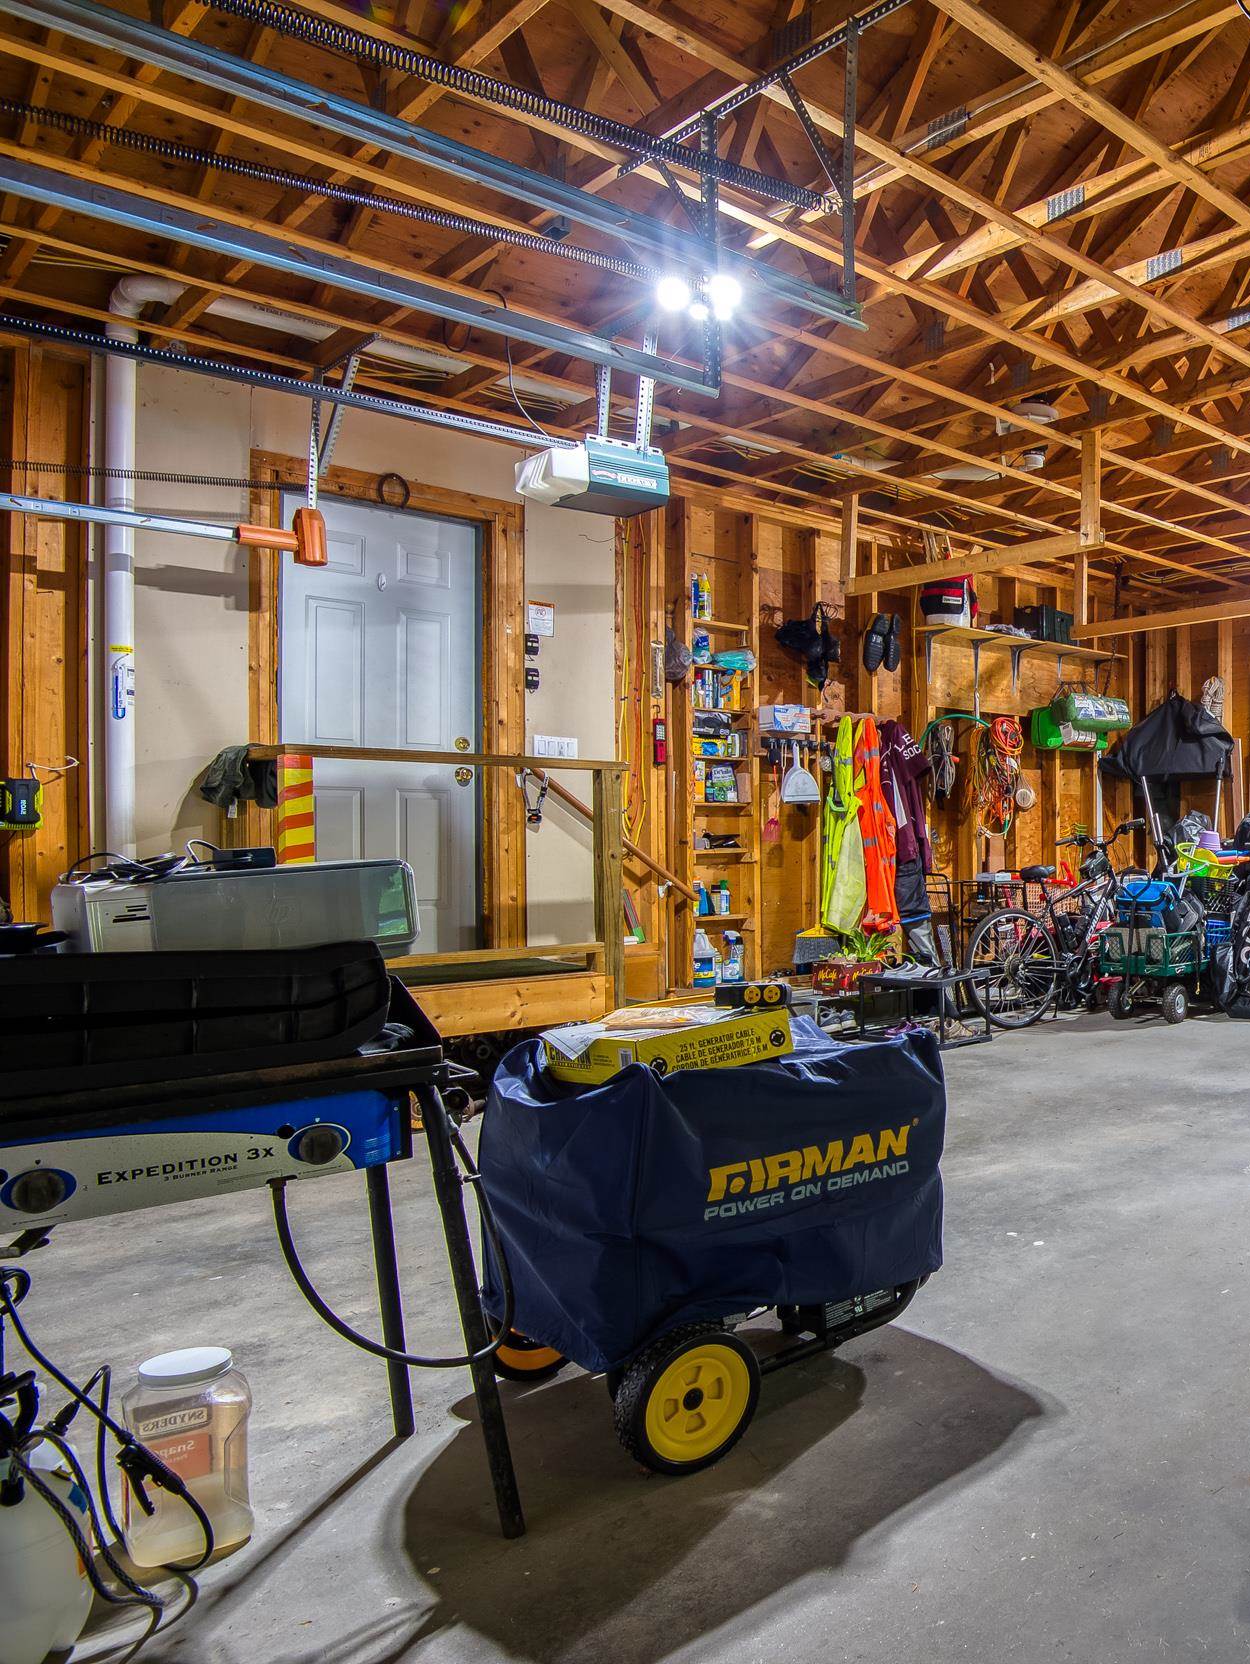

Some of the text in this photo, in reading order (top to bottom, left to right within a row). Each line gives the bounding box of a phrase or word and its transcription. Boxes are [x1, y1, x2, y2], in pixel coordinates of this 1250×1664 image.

[675, 1052, 696, 1063] CABLE
[698, 1048, 707, 1057] DE
[708, 1040, 744, 1055] GENERADOR
[680, 1044, 688, 1052] 25
[698, 1032, 734, 1048] GENERATOR
[735, 1028, 755, 1039] CABLE
[700, 1057, 709, 1067] DE
[762, 1043, 768, 1051] M
[97, 1153, 238, 1186] EXPEDITION
[172, 1170, 207, 1181] BURNER
[209, 1165, 238, 1174] RANGE
[707, 1124, 911, 1202] FIRMAN
[704, 1160, 910, 1221] POWER ON DEMAND
